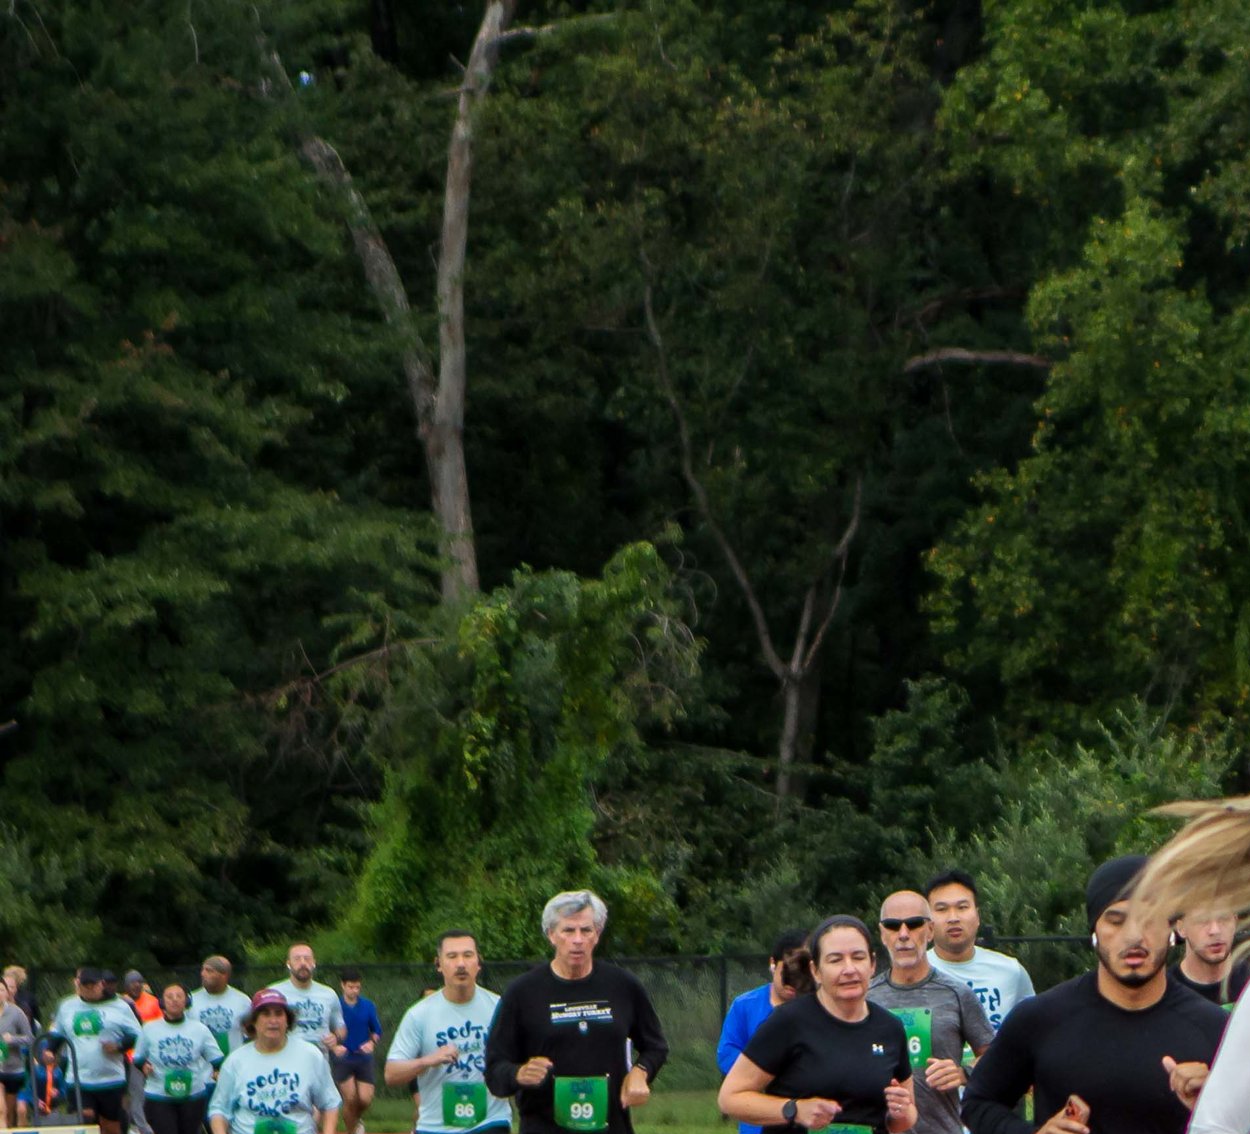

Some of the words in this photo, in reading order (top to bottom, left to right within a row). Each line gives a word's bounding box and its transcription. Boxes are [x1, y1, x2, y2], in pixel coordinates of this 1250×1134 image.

[246, 1067, 300, 1097] SOUTH
[454, 1103, 475, 1118] 86
[571, 1103, 594, 1119] 99
